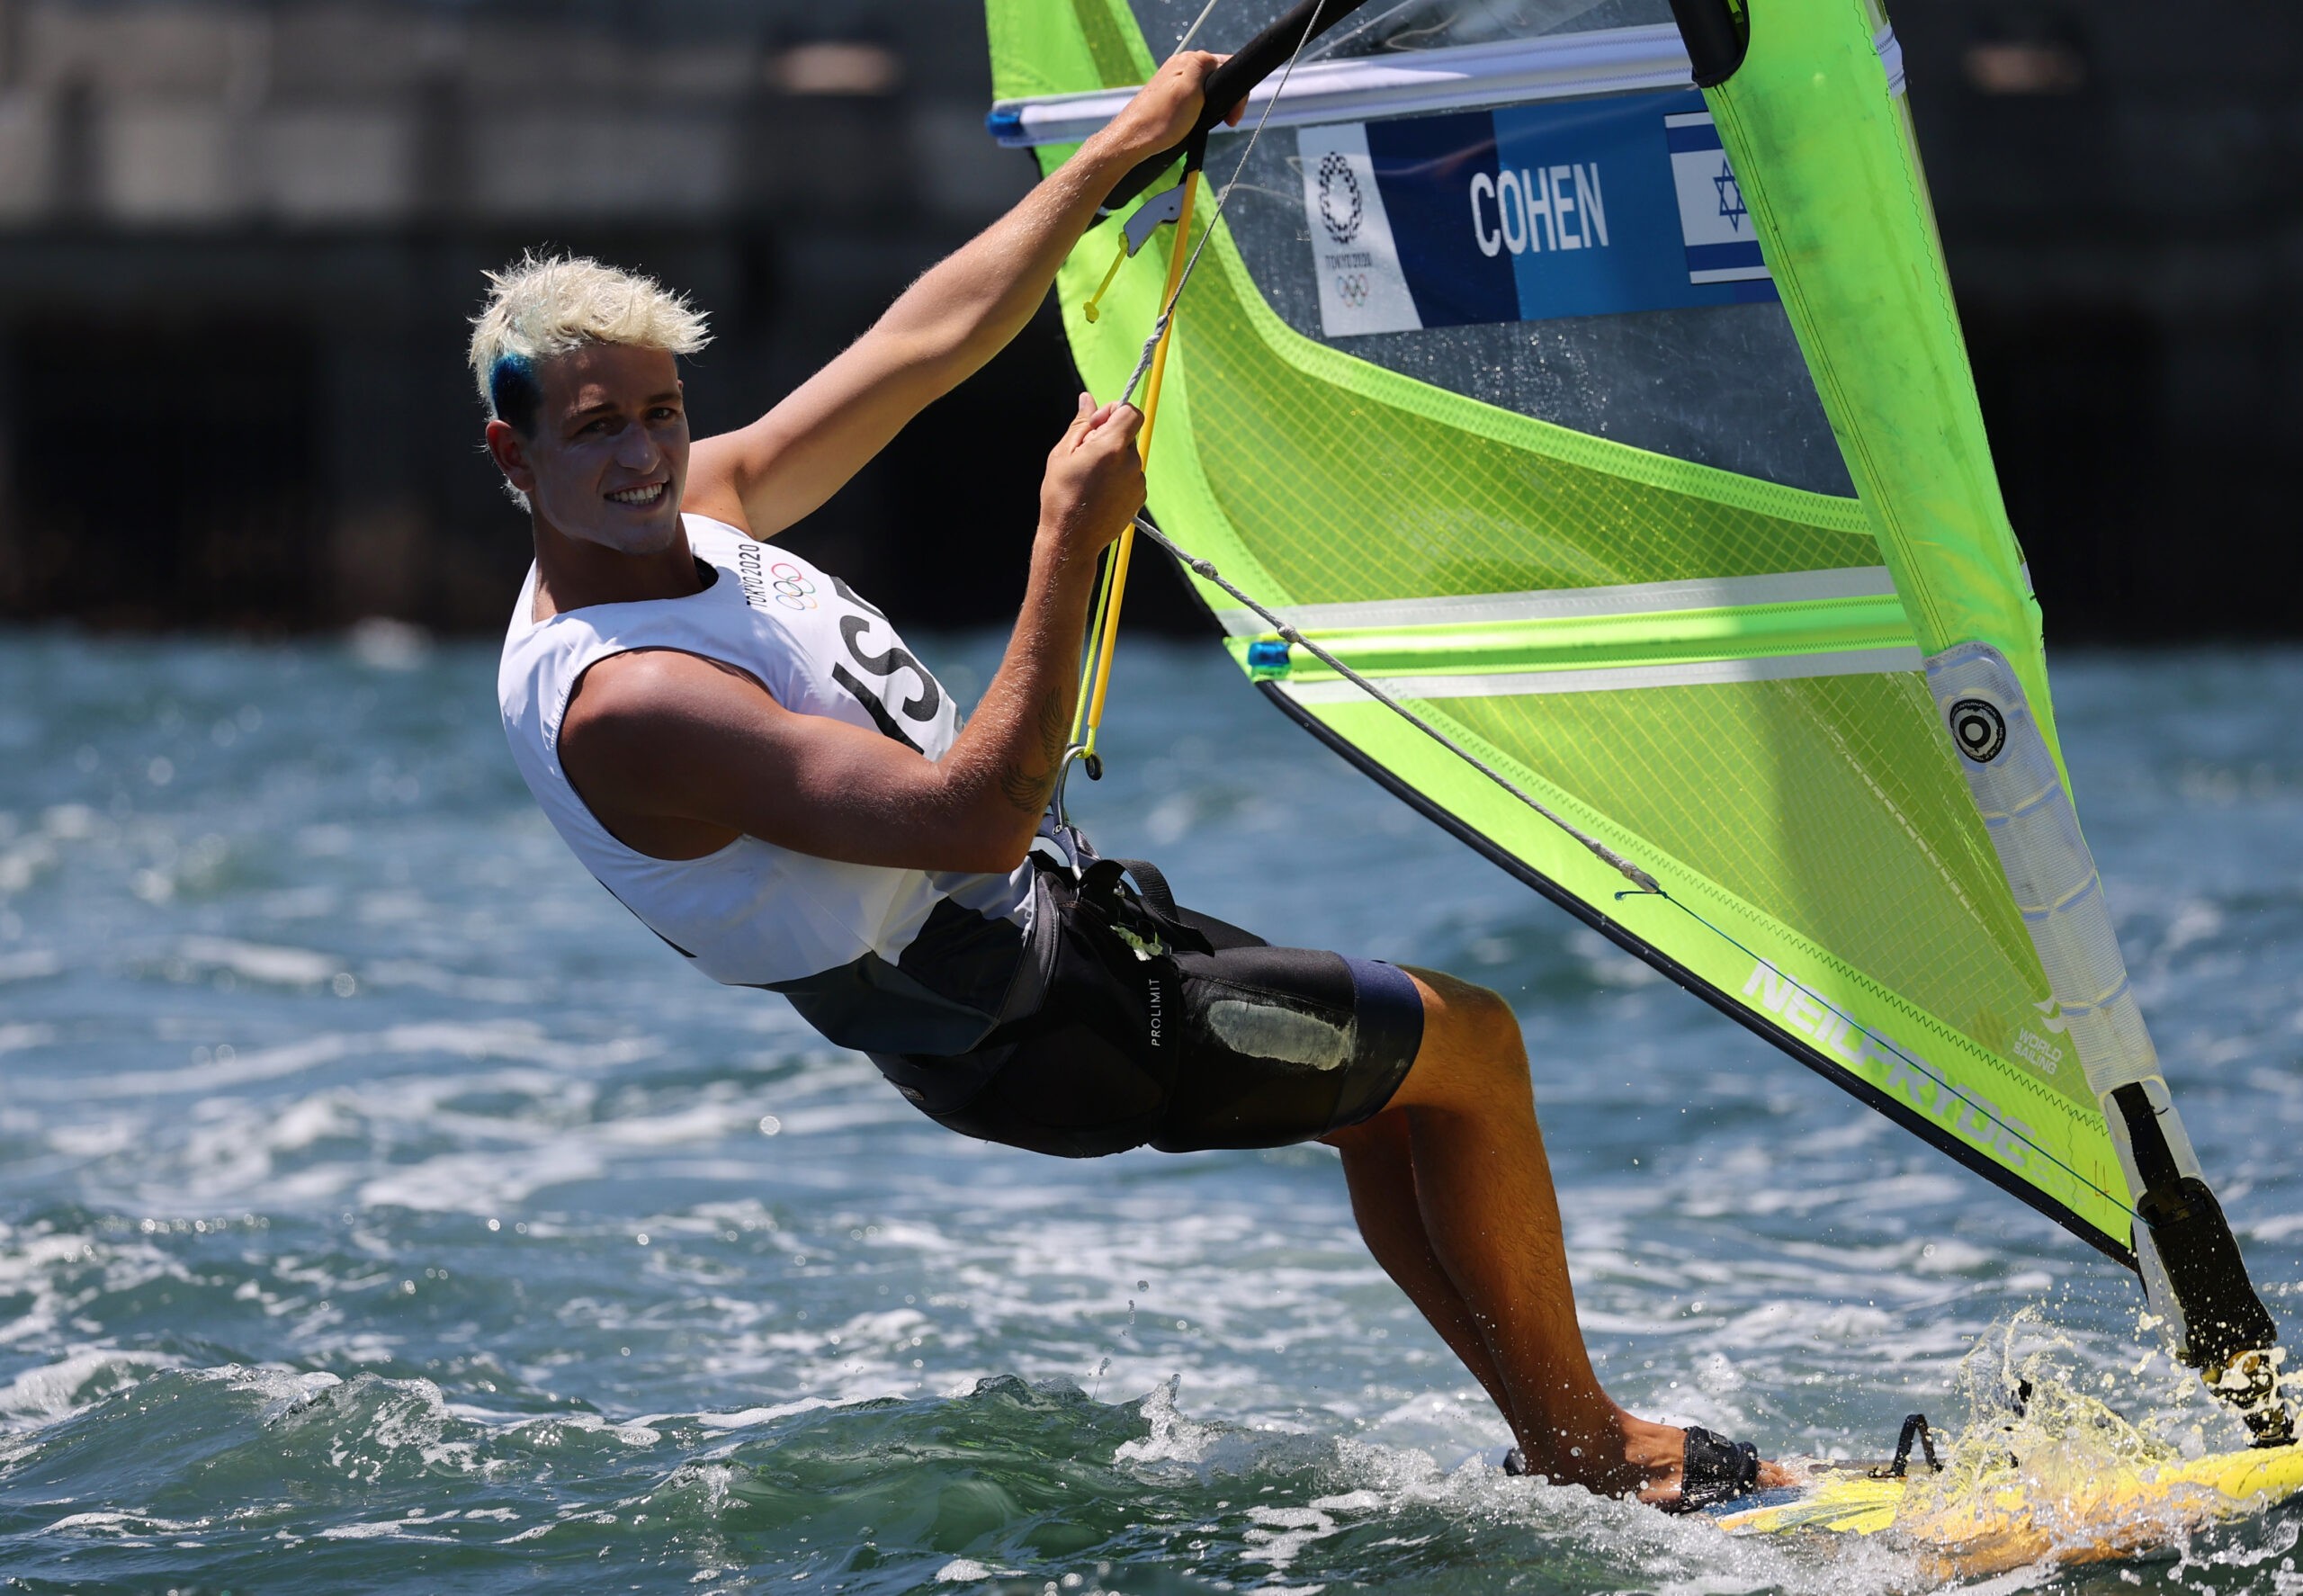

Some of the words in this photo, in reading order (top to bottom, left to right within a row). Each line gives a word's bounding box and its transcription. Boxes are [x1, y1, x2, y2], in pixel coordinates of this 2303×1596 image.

[1469, 162, 1609, 257] COHEN
[738, 543, 762, 577] 2020
[831, 576, 941, 756] IS
[1148, 978, 1161, 1046] PROLIMIT
[2013, 1041, 2057, 1075] SAILING
[2019, 1027, 2062, 1062] WORLD
